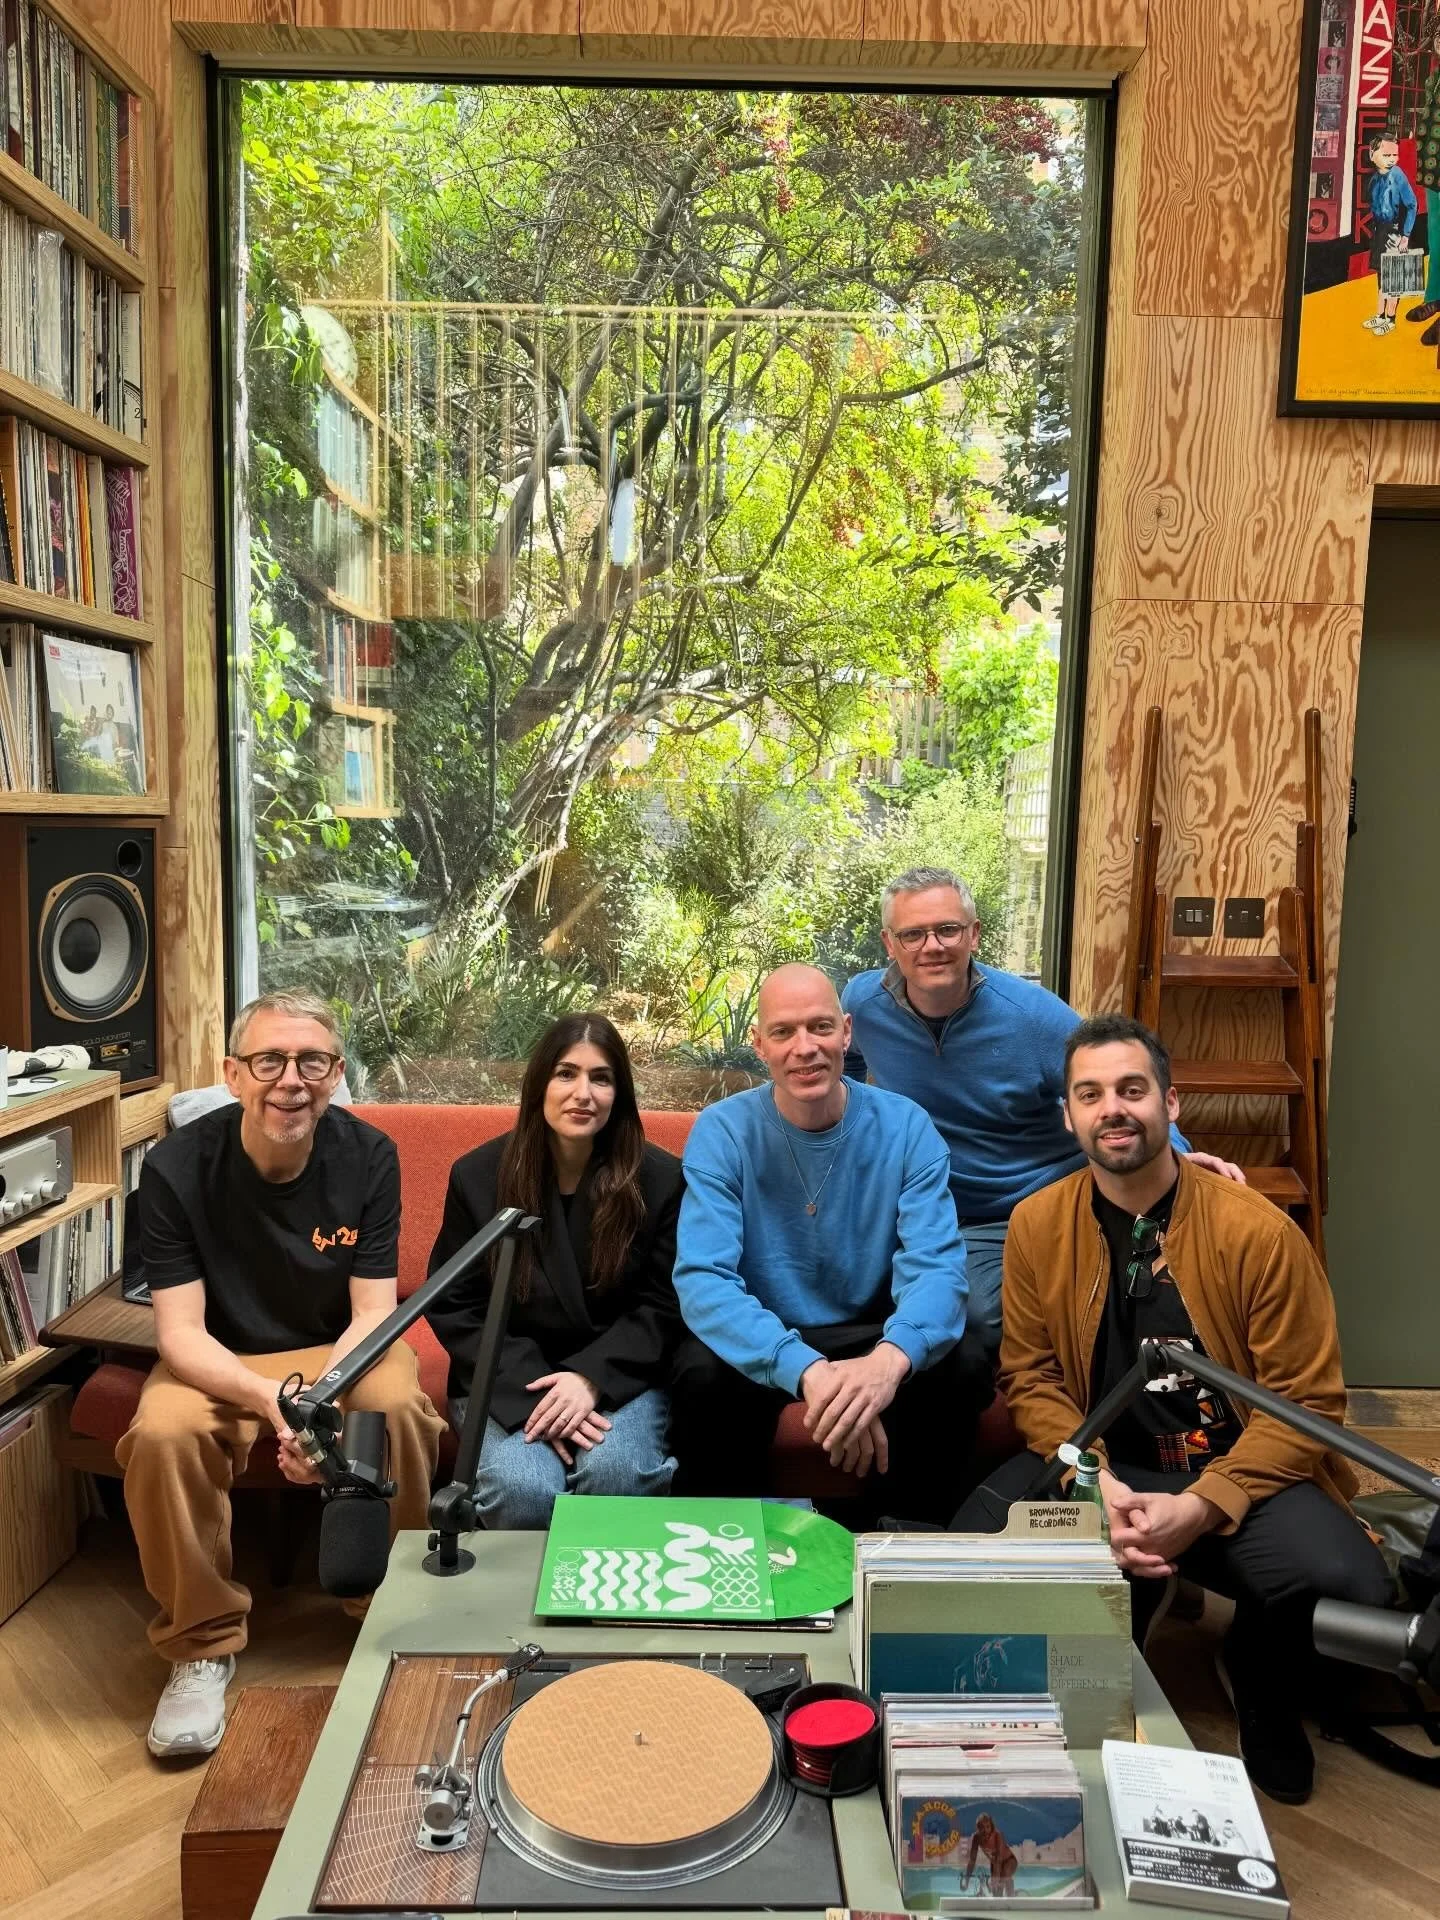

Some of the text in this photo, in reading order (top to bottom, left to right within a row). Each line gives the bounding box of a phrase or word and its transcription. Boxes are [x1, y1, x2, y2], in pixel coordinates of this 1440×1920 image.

[134, 407, 141, 419] 2
[1028, 1506, 1081, 1517] BROWNSWOOD
[1029, 1517, 1078, 1528] RECORDINGS
[1050, 1655, 1085, 1666] SHADE
